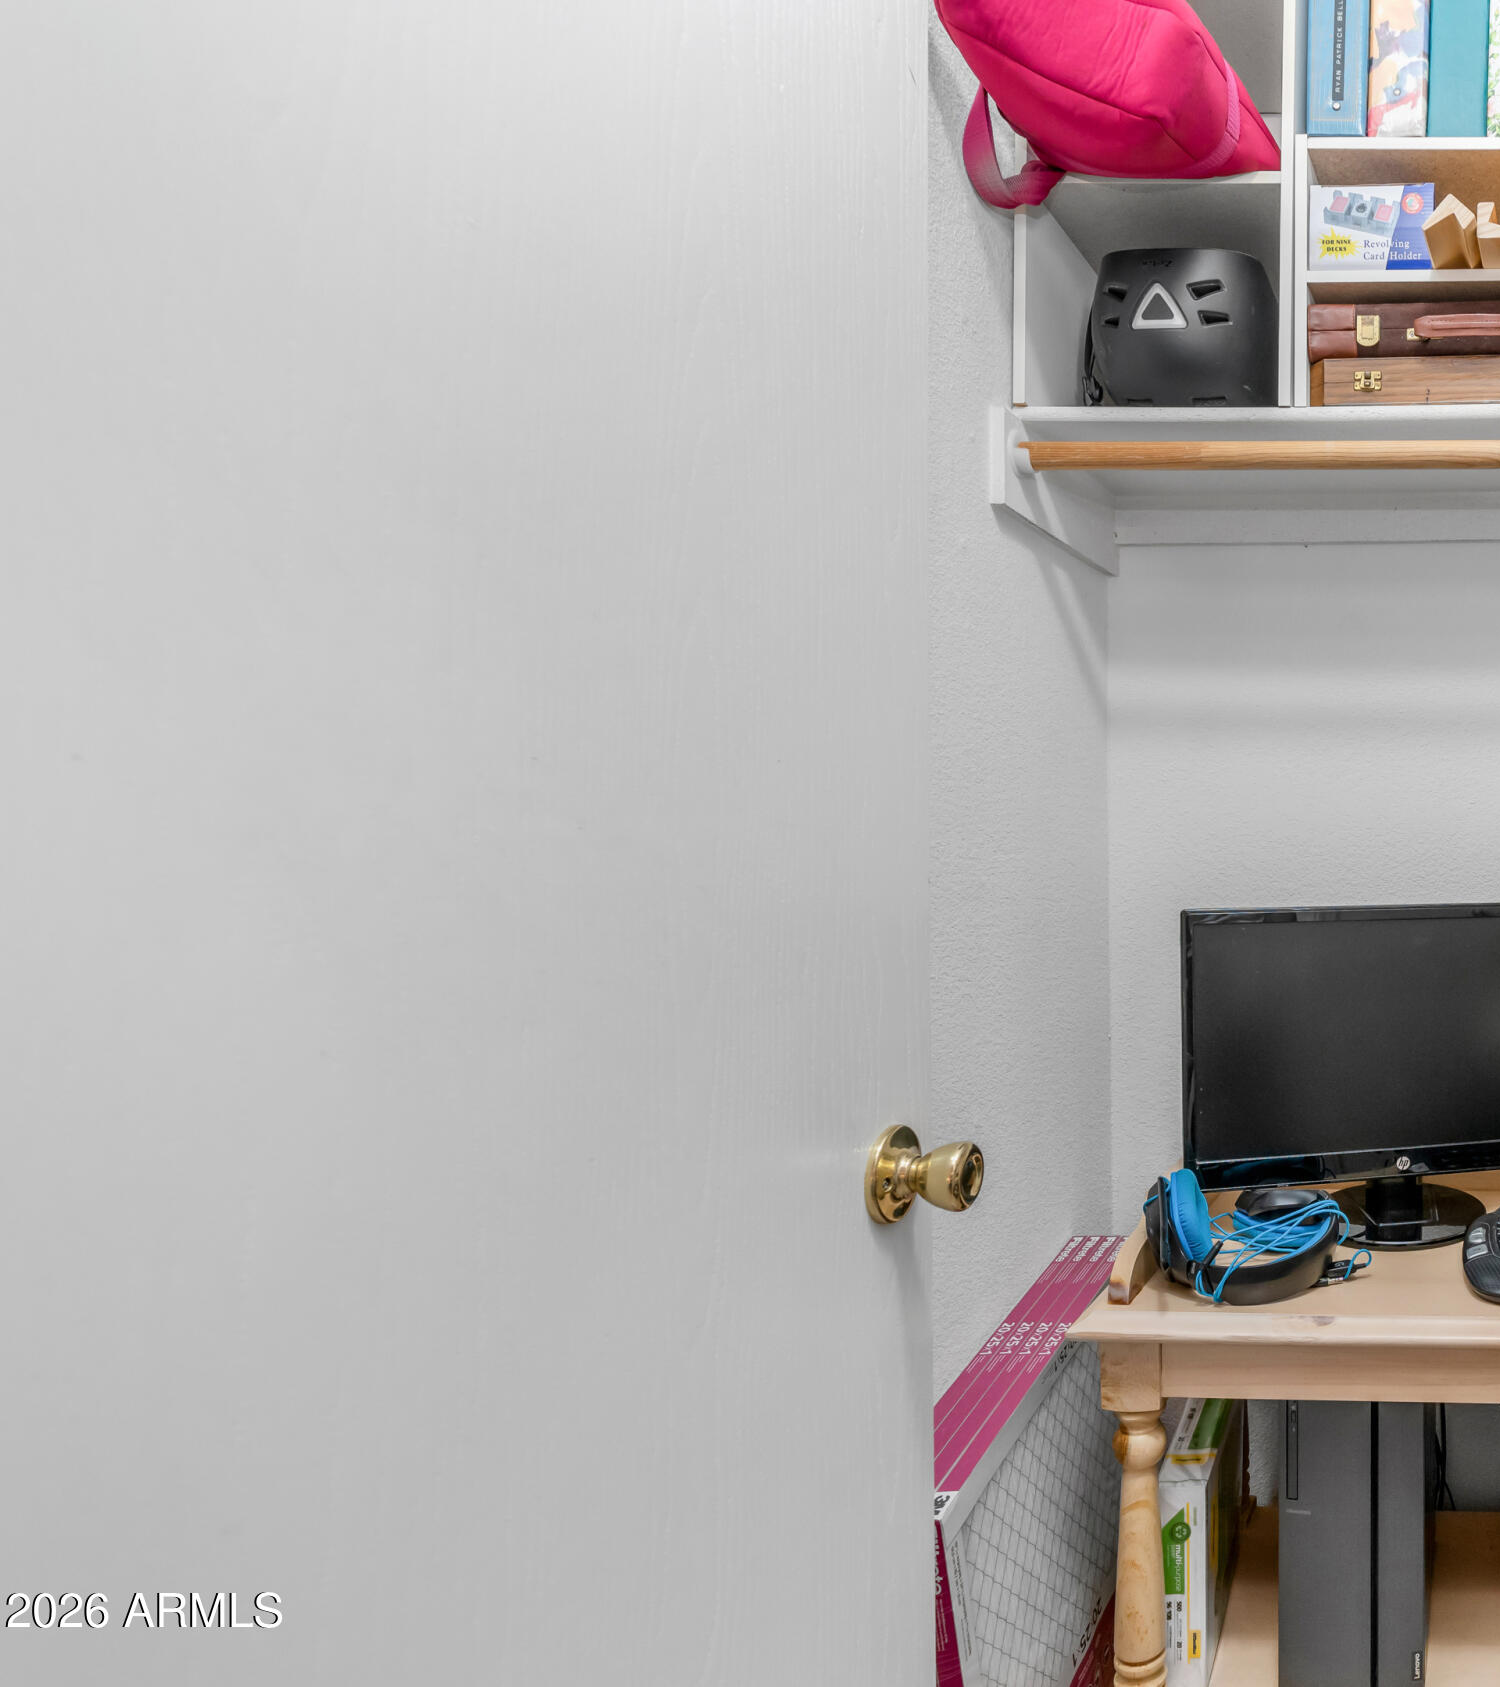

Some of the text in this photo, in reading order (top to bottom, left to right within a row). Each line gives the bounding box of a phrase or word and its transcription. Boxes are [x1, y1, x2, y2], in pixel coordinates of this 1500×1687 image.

[1363, 239, 1410, 249] Revolving
[1363, 251, 1422, 260] Card Holder
[1398, 1156, 1409, 1170] hp
[1413, 1652, 1421, 1680] Lenovo
